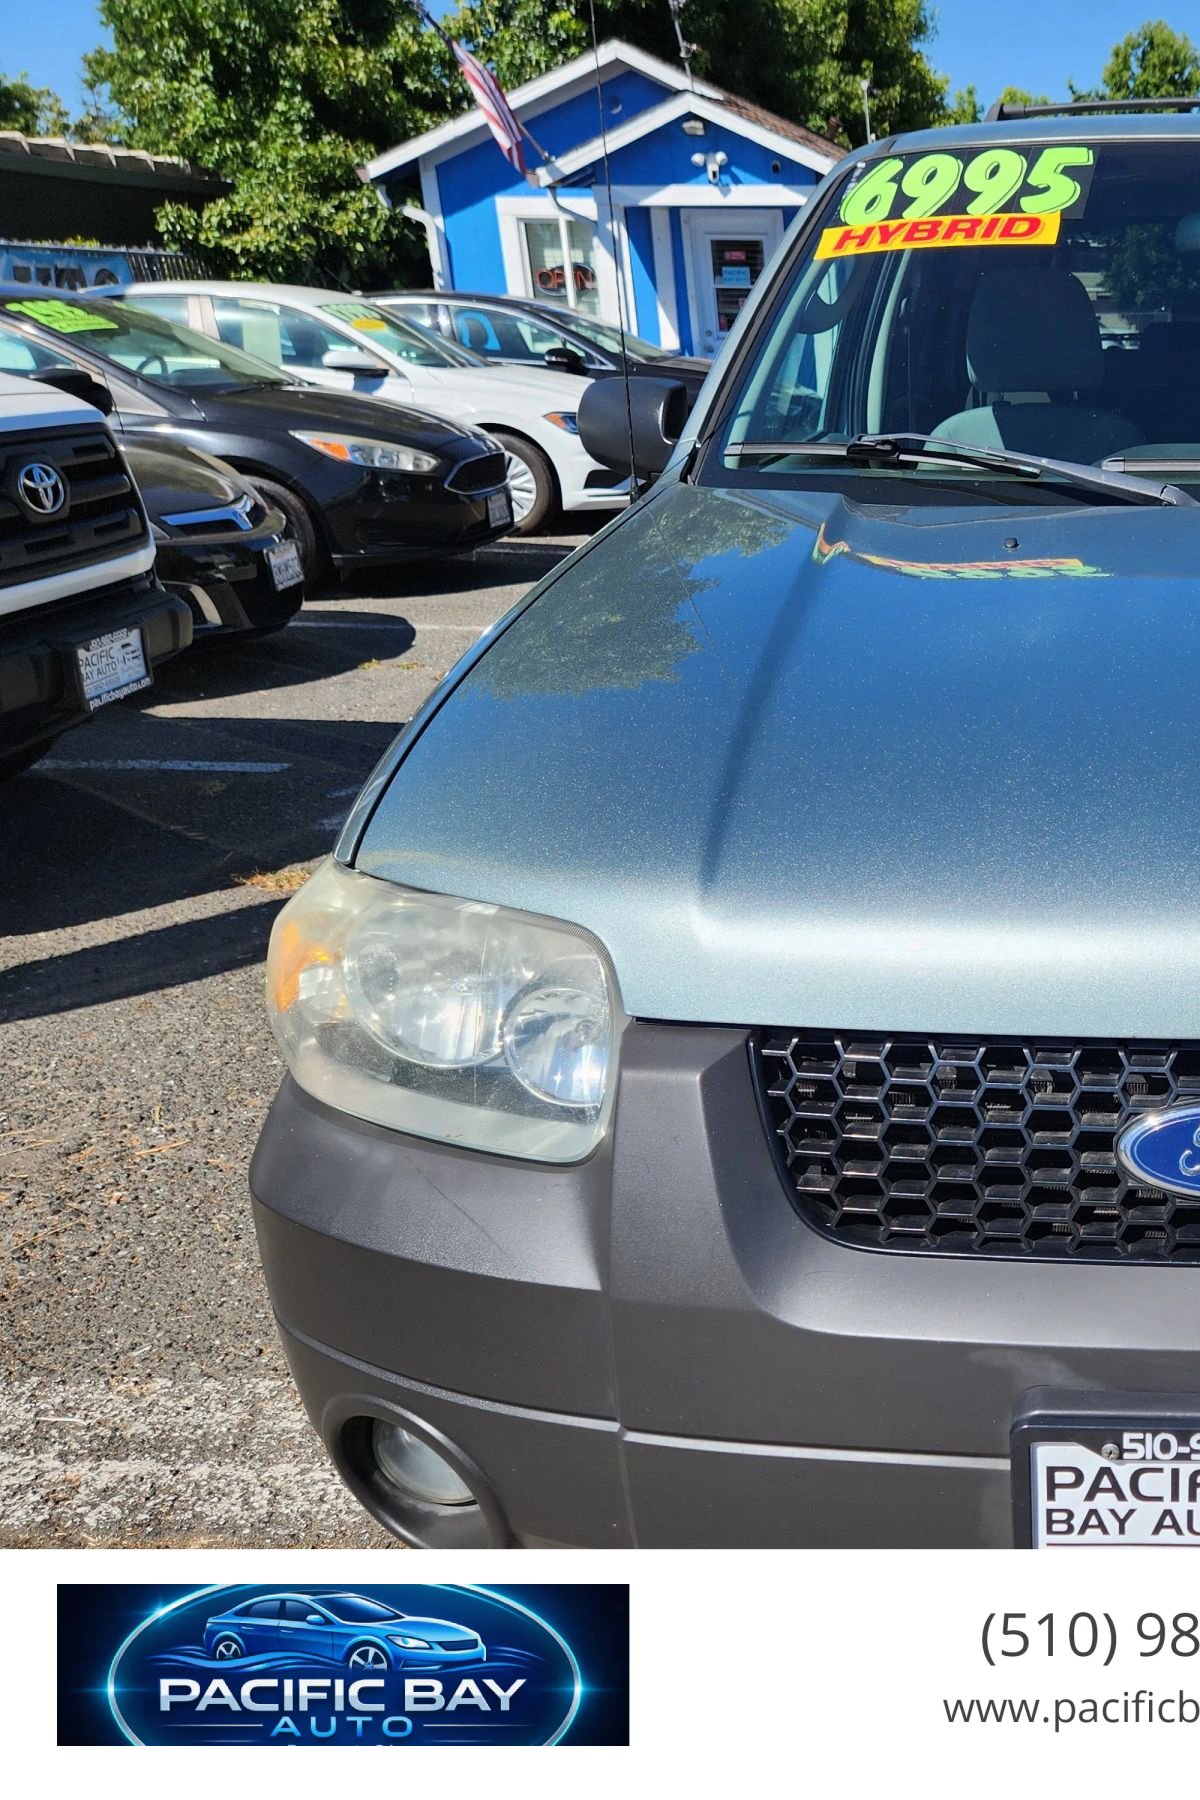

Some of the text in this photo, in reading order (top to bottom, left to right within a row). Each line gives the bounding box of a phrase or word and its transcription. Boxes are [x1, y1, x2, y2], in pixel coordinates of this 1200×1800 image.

[840, 147, 1093, 226] 6995
[832, 216, 1045, 250] HYBRID
[536, 267, 594, 290] OPN
[1046, 1507, 1139, 1537] BAY
